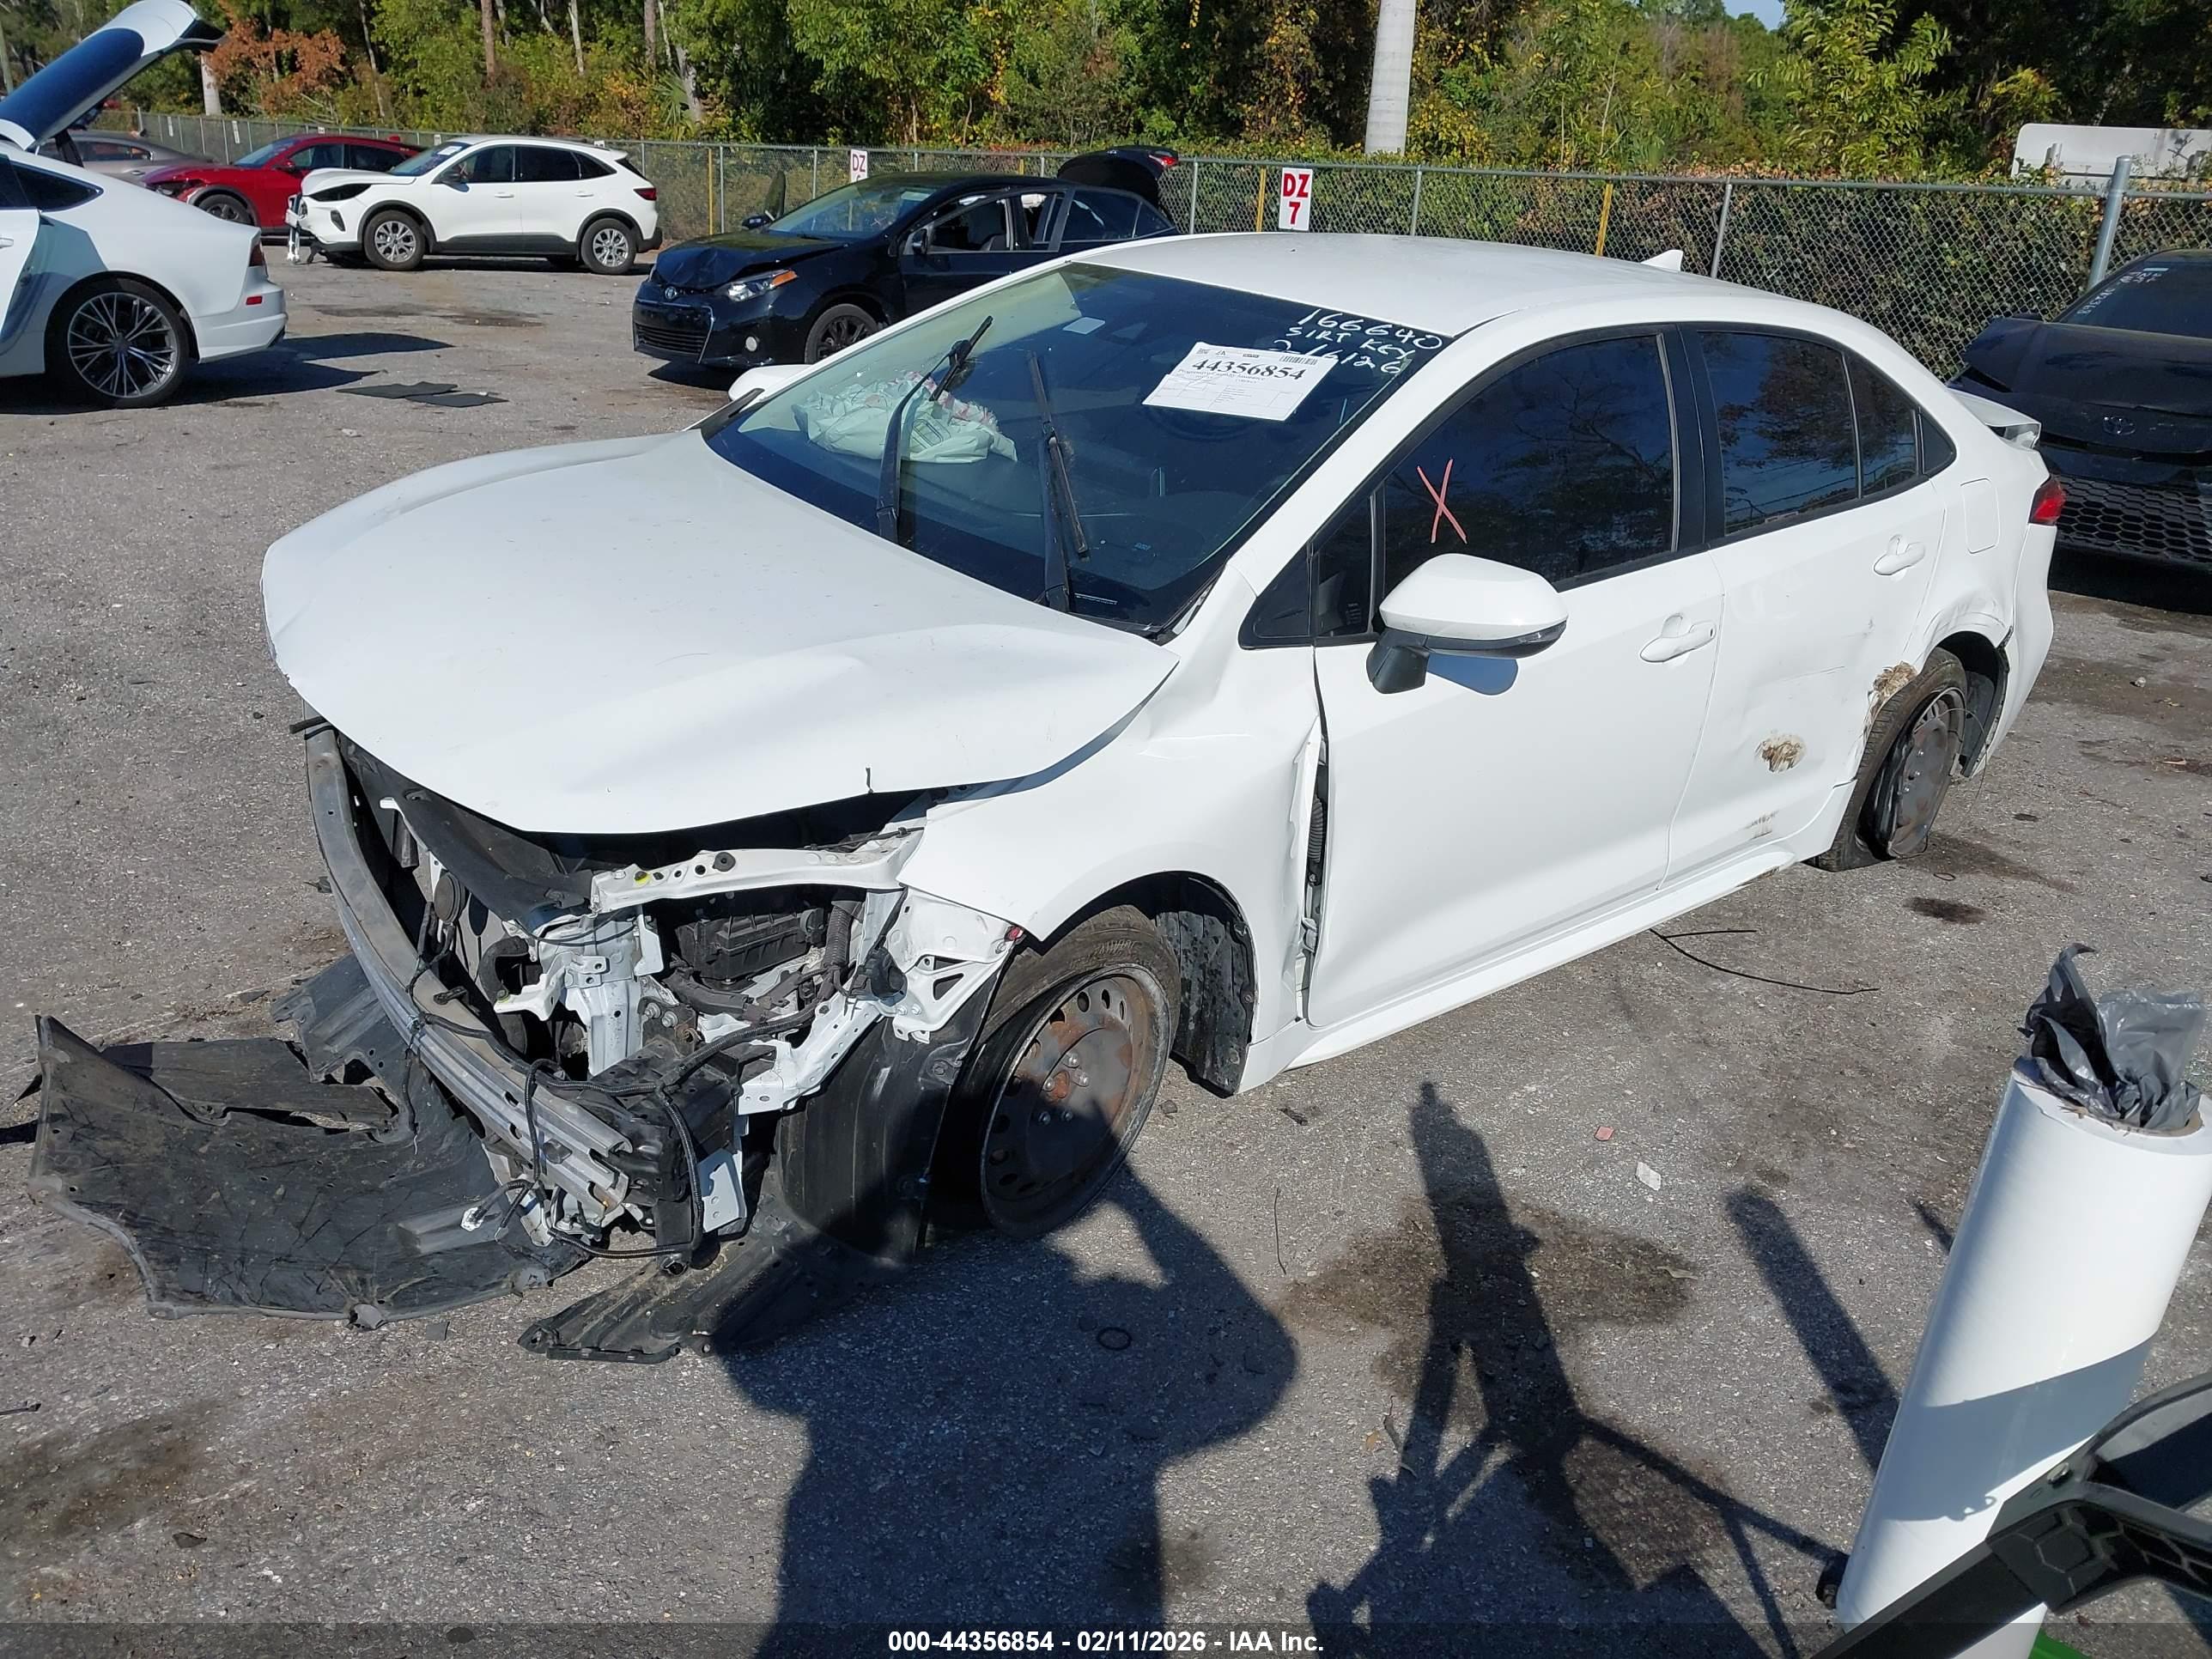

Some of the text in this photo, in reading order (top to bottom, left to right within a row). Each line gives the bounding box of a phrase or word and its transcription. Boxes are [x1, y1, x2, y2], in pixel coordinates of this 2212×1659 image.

[853, 154, 866, 172] DZ
[1283, 173, 1310, 198] DZ
[1289, 201, 1301, 225] 7
[1298, 308, 1443, 349] 166640
[1192, 359, 1307, 380] 44356854
